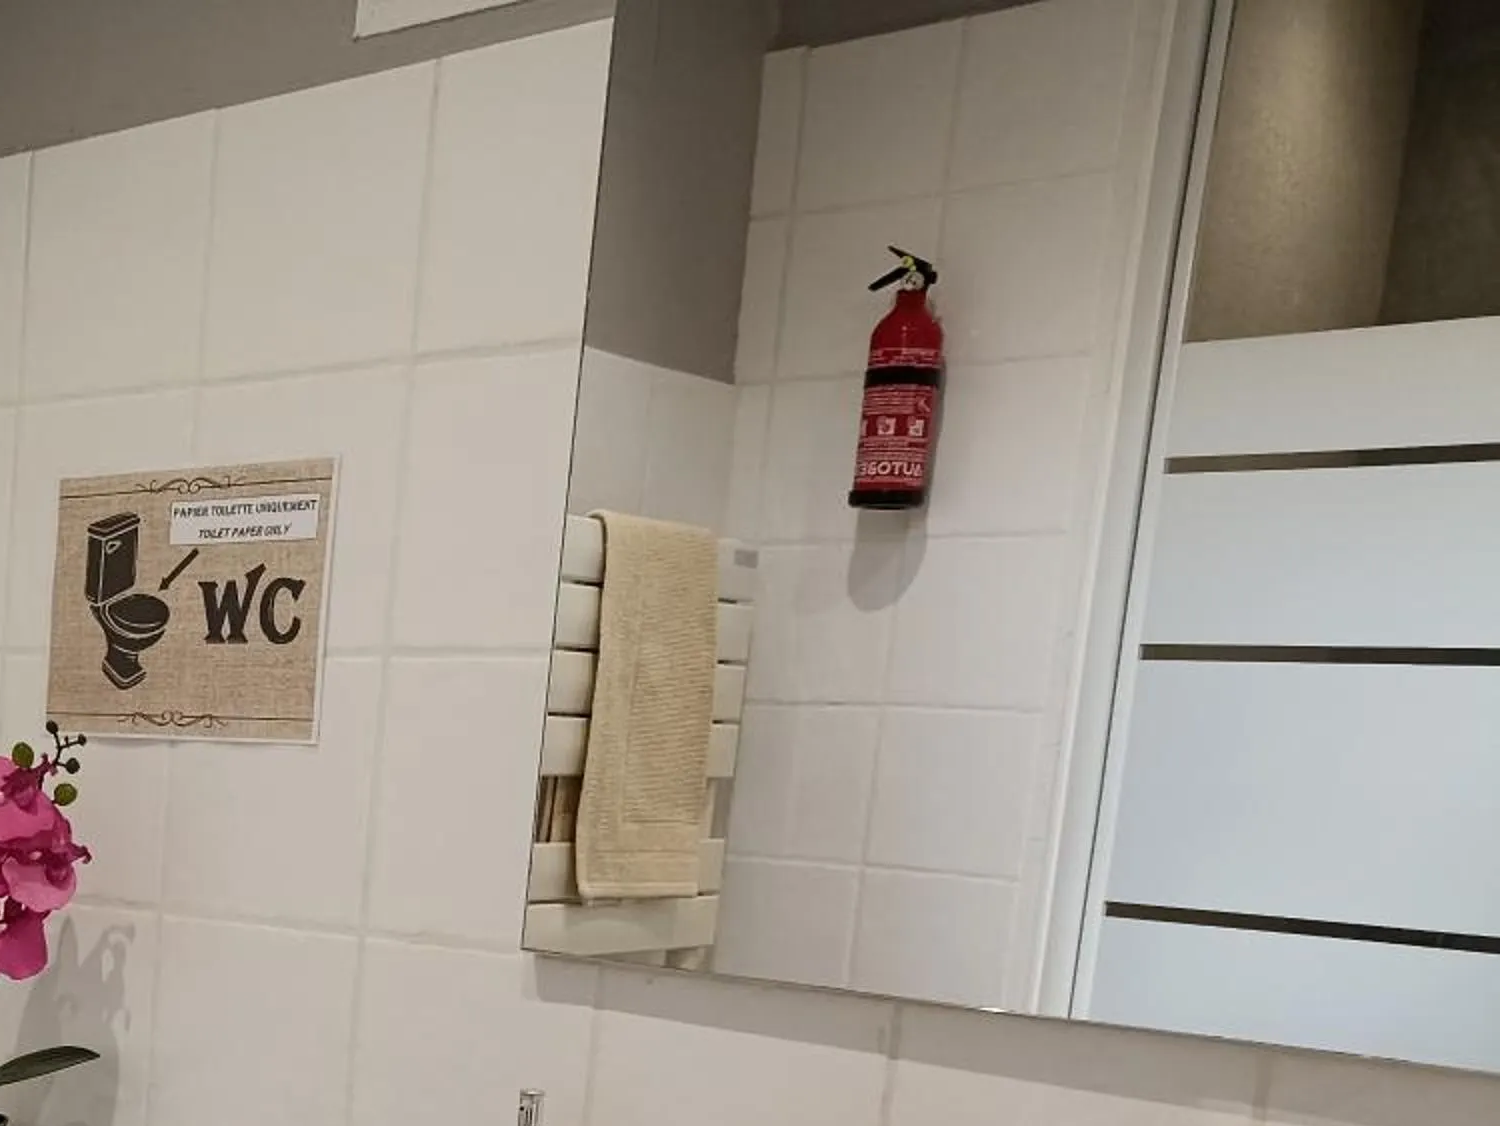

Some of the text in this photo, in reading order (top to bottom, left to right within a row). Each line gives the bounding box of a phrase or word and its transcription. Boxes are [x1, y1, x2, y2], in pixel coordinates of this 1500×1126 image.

[173, 499, 317, 518] PAPIER TOILETTE UNIQUEMENT
[198, 523, 293, 539] TOILET PAPER ONLY
[198, 563, 306, 645] WC
